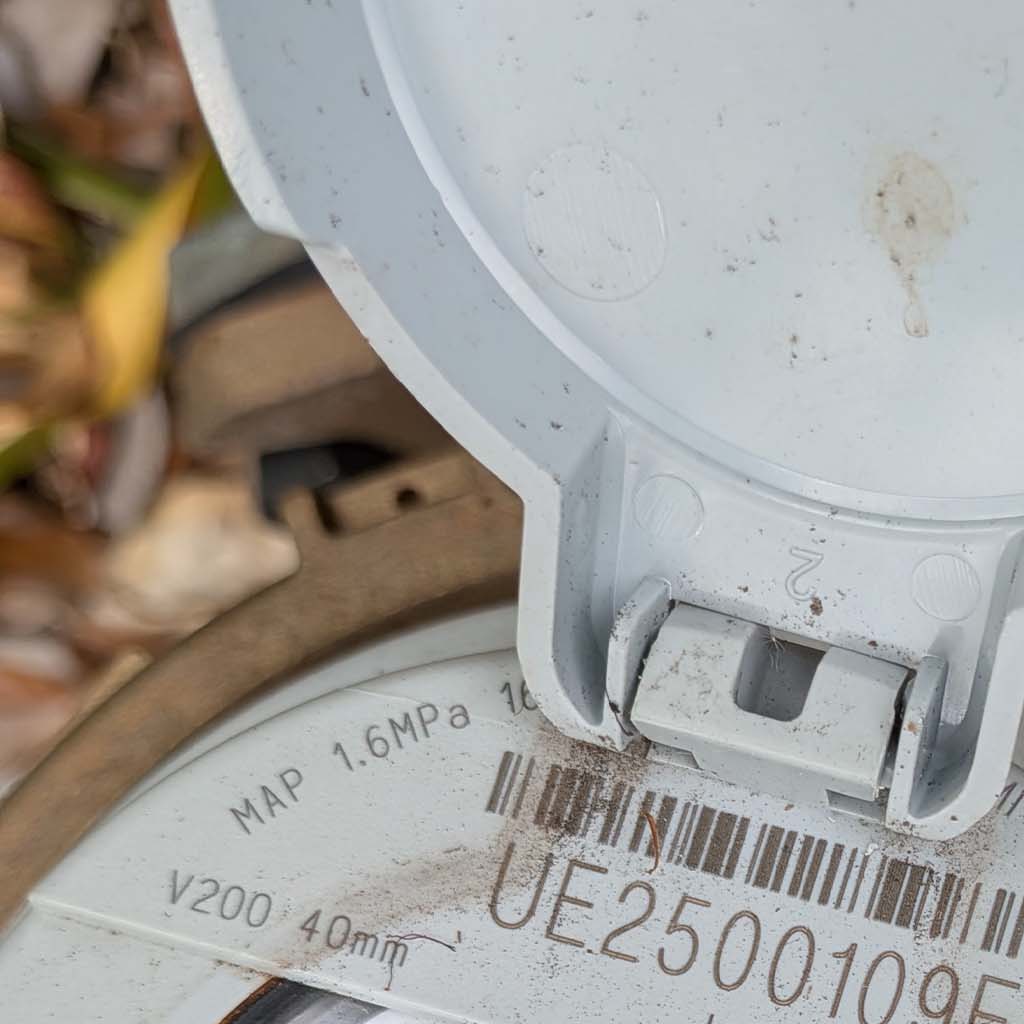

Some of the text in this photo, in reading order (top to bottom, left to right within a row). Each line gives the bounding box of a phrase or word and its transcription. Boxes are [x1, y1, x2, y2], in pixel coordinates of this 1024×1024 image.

[228, 768, 304, 834] MAP
[332, 701, 471, 772] 1.6MPa
[168, 868, 409, 968] V200 40mm
